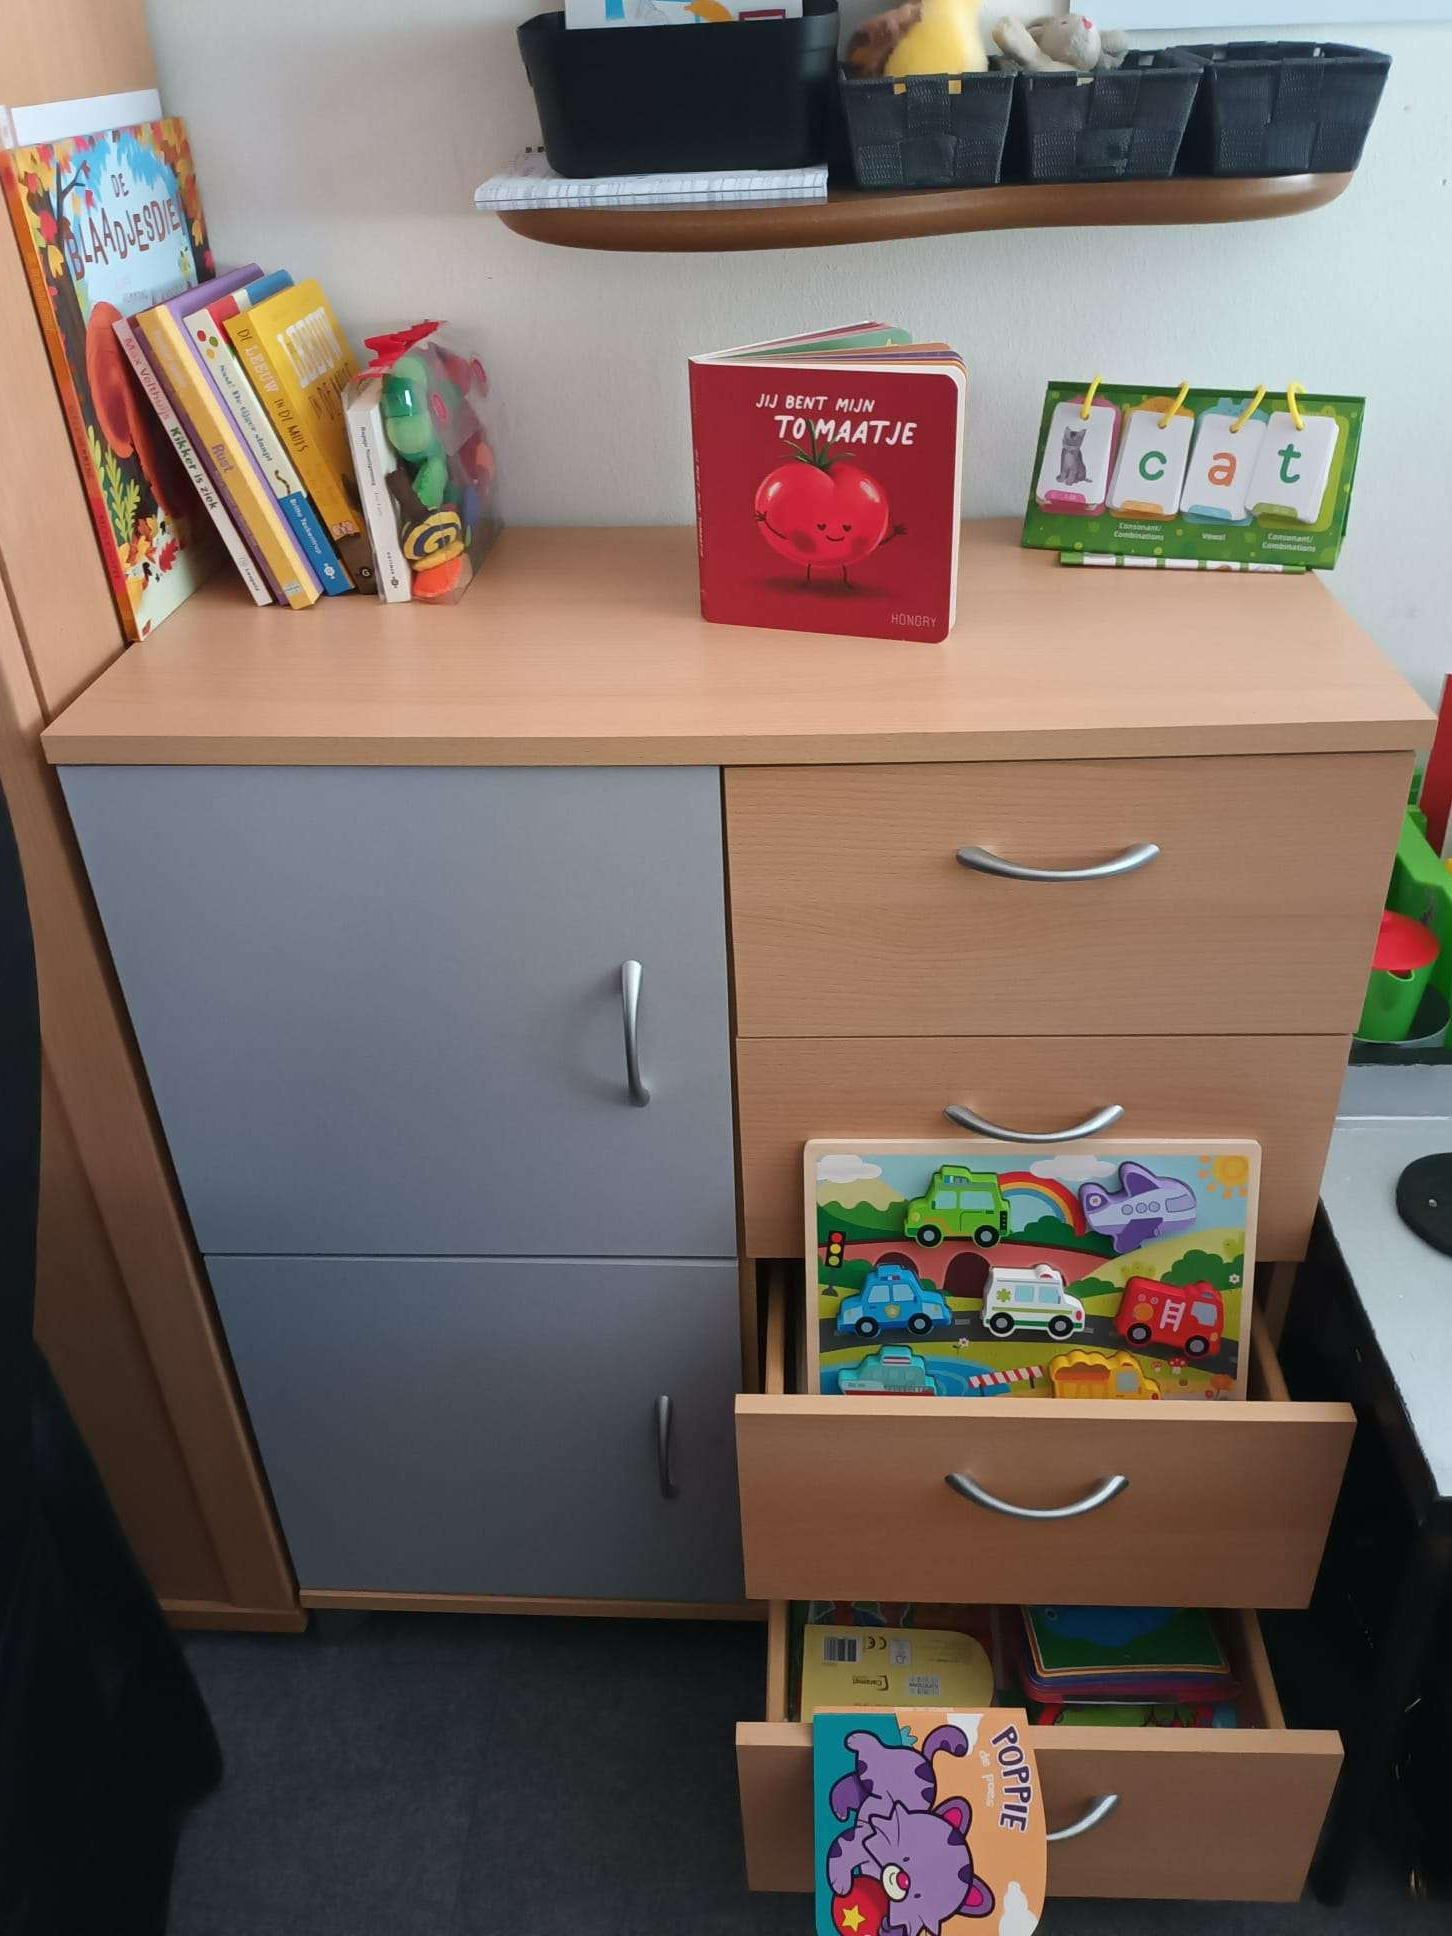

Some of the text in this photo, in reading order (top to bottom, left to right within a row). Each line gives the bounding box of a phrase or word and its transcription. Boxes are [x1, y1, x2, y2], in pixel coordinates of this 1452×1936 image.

[110, 173, 129, 198] DE
[273, 397, 285, 409] IN
[756, 394, 875, 413] JIJ BENT MIJN
[773, 415, 918, 446] TOMAATJE
[211, 442, 235, 473] Rust
[1138, 443, 1301, 487] c a t
[169, 425, 218, 510] Kikker is ziek
[1113, 530, 1165, 543] Combinations
[1267, 532, 1314, 545] Consonant/
[1262, 541, 1317, 553] Combinations
[891, 613, 937, 627] HONGRY
[979, 1750, 991, 1768] de
[991, 1725, 1032, 1832] POPPIE
